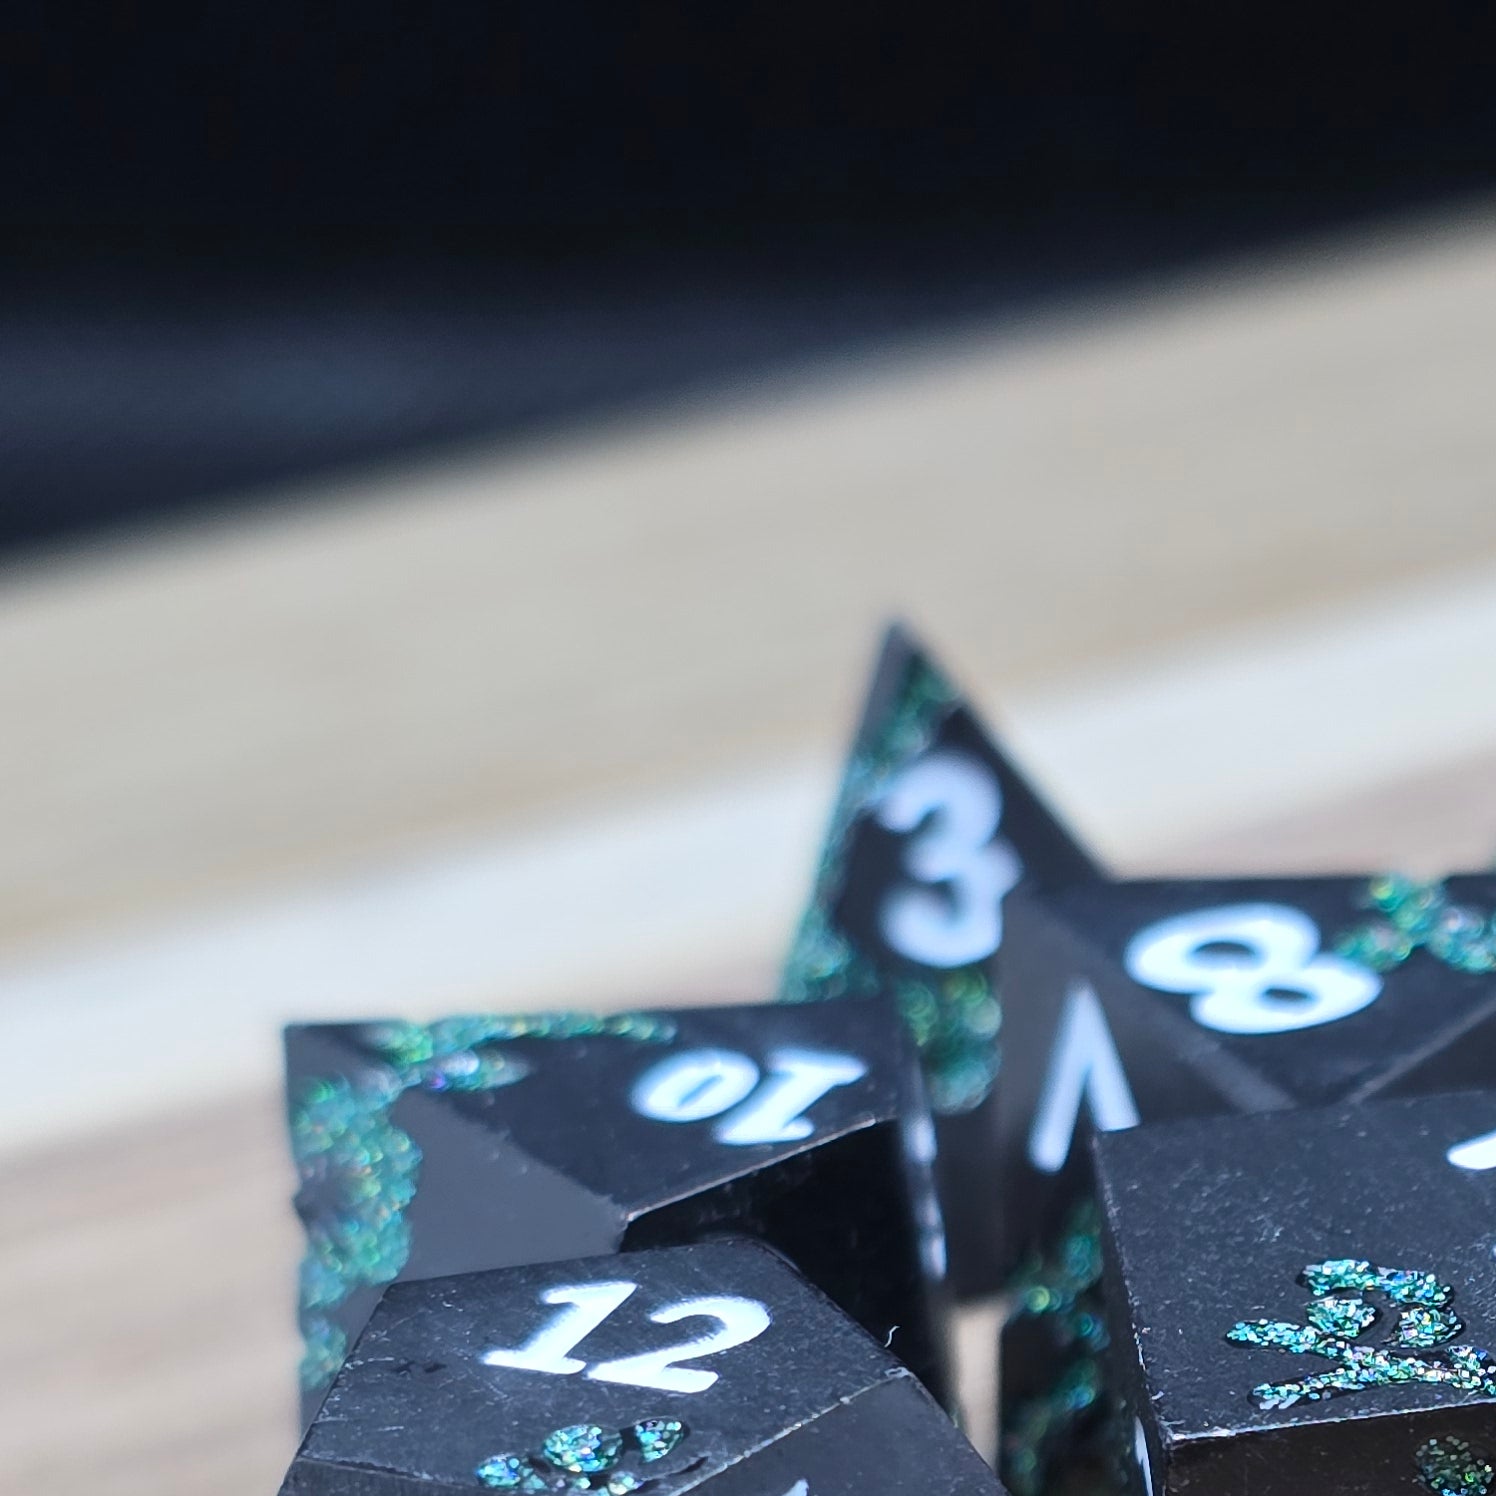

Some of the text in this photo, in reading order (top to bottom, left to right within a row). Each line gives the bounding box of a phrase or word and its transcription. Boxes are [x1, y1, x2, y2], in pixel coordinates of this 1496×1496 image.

[873, 750, 1022, 968] 3
[1124, 902, 1382, 1035] 8
[478, 1279, 772, 1395] 12
